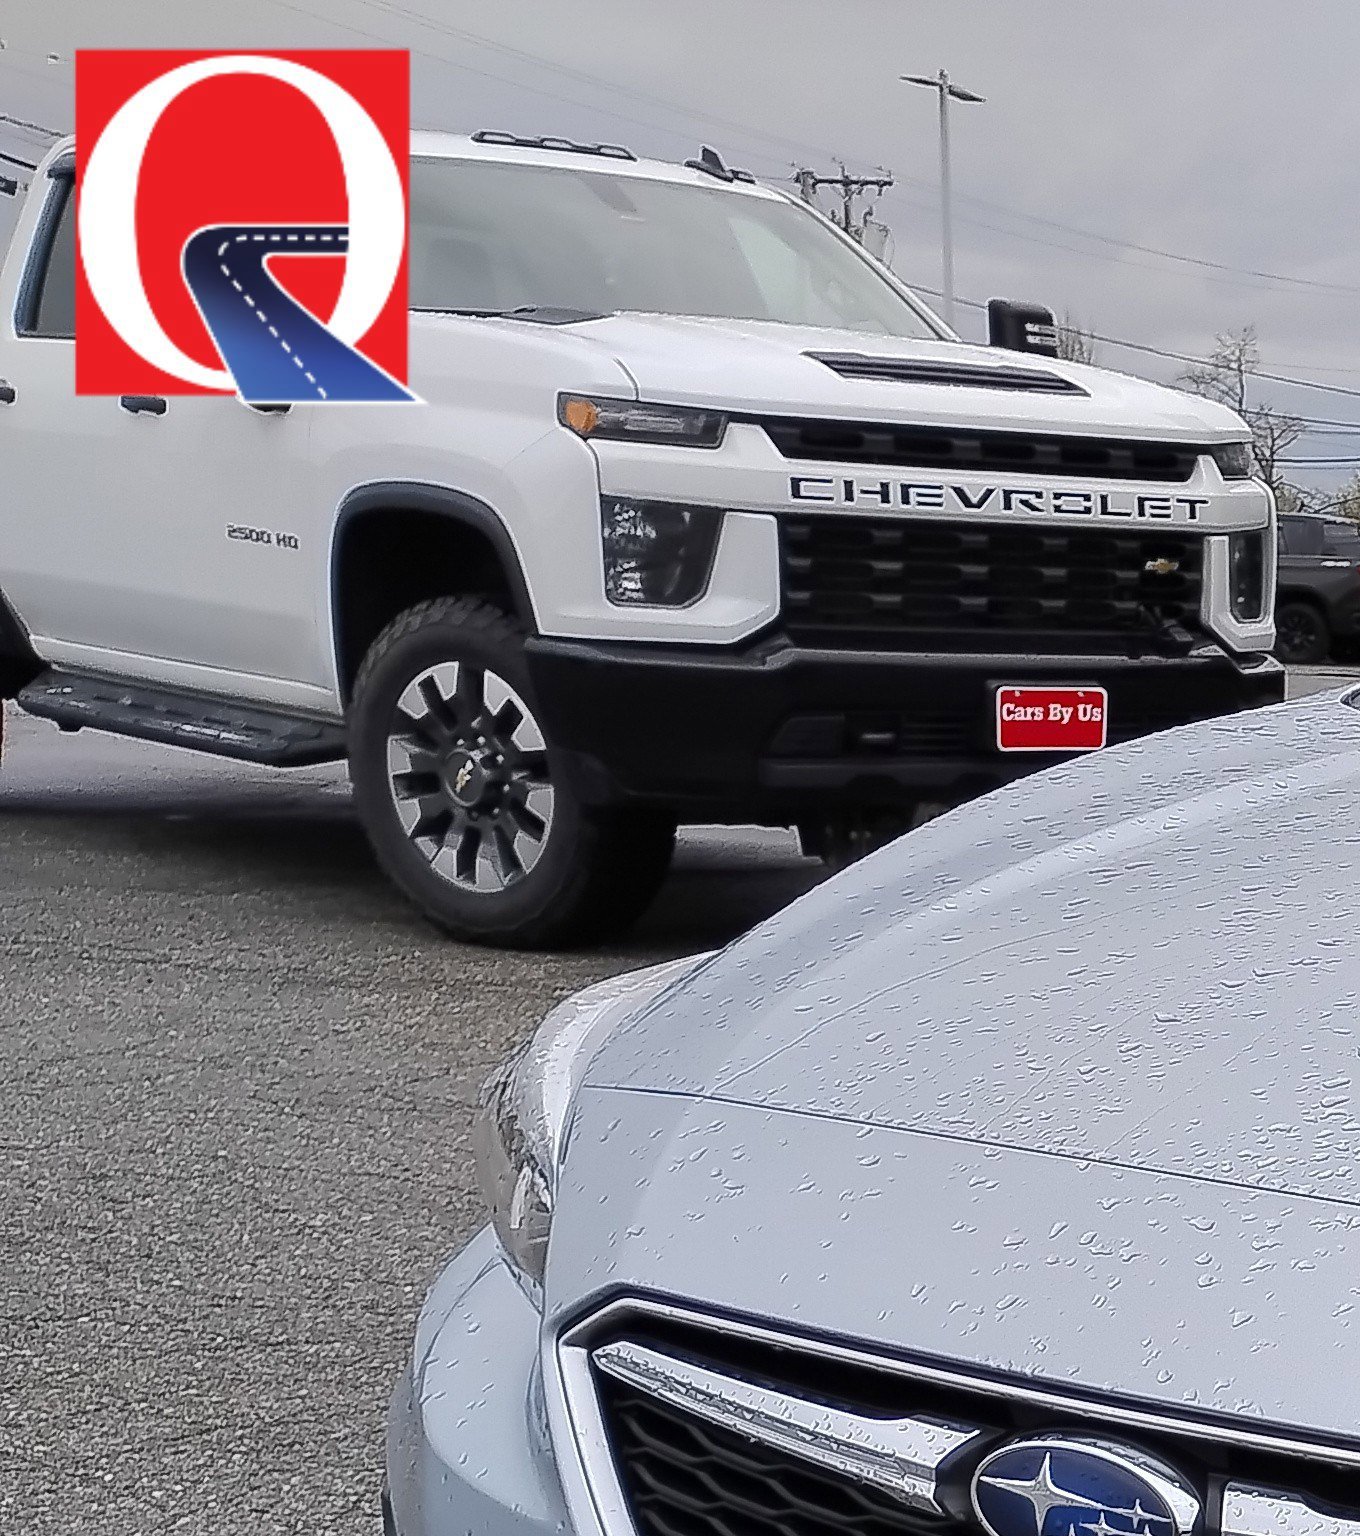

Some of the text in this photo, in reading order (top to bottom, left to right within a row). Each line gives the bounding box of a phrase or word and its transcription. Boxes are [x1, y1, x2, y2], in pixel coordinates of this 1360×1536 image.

[789, 475, 1210, 521] CHEVROLET
[226, 524, 299, 550] 2500 HD
[1001, 703, 1102, 725] Cars By Us
